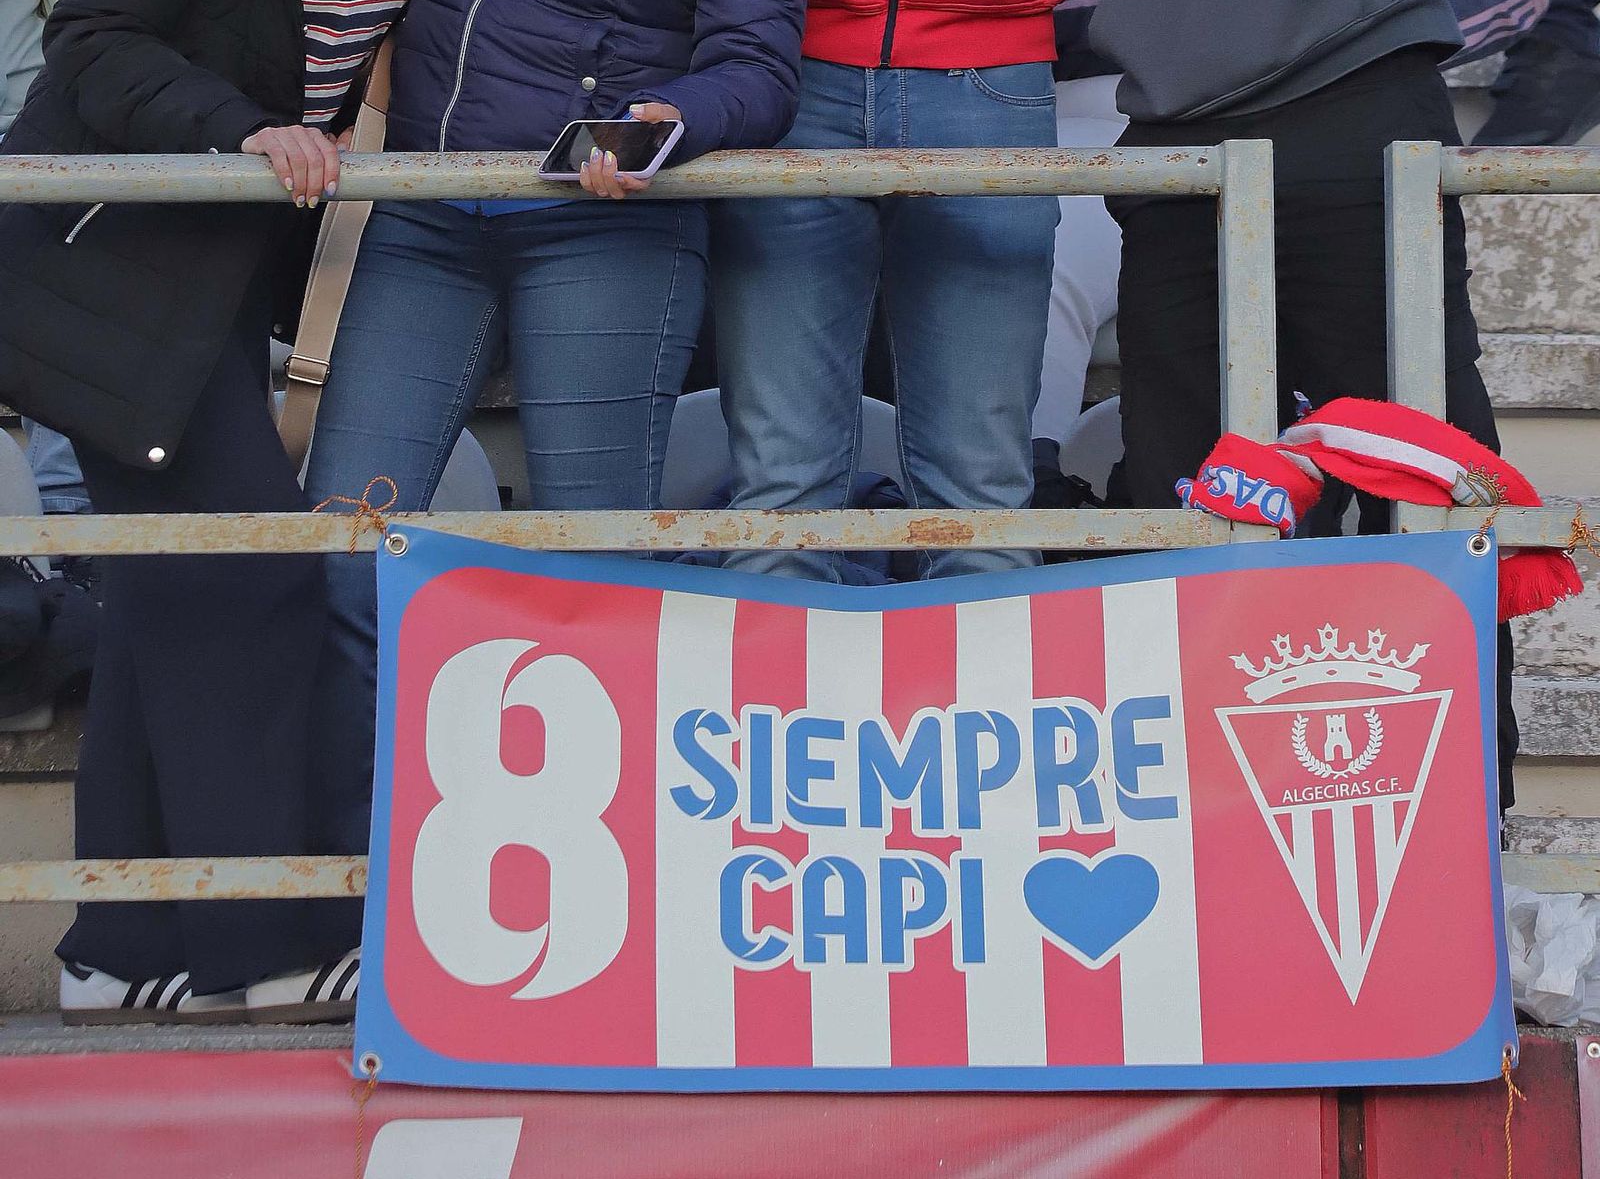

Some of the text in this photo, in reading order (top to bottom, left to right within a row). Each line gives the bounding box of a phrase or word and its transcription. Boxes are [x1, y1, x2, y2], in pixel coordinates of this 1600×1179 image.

[412, 638, 629, 1000] 8
[669, 695, 1178, 830] SIEMPRE
[1282, 777, 1402, 803] ALGECIRAS C.F.
[719, 853, 986, 964] CAPI
